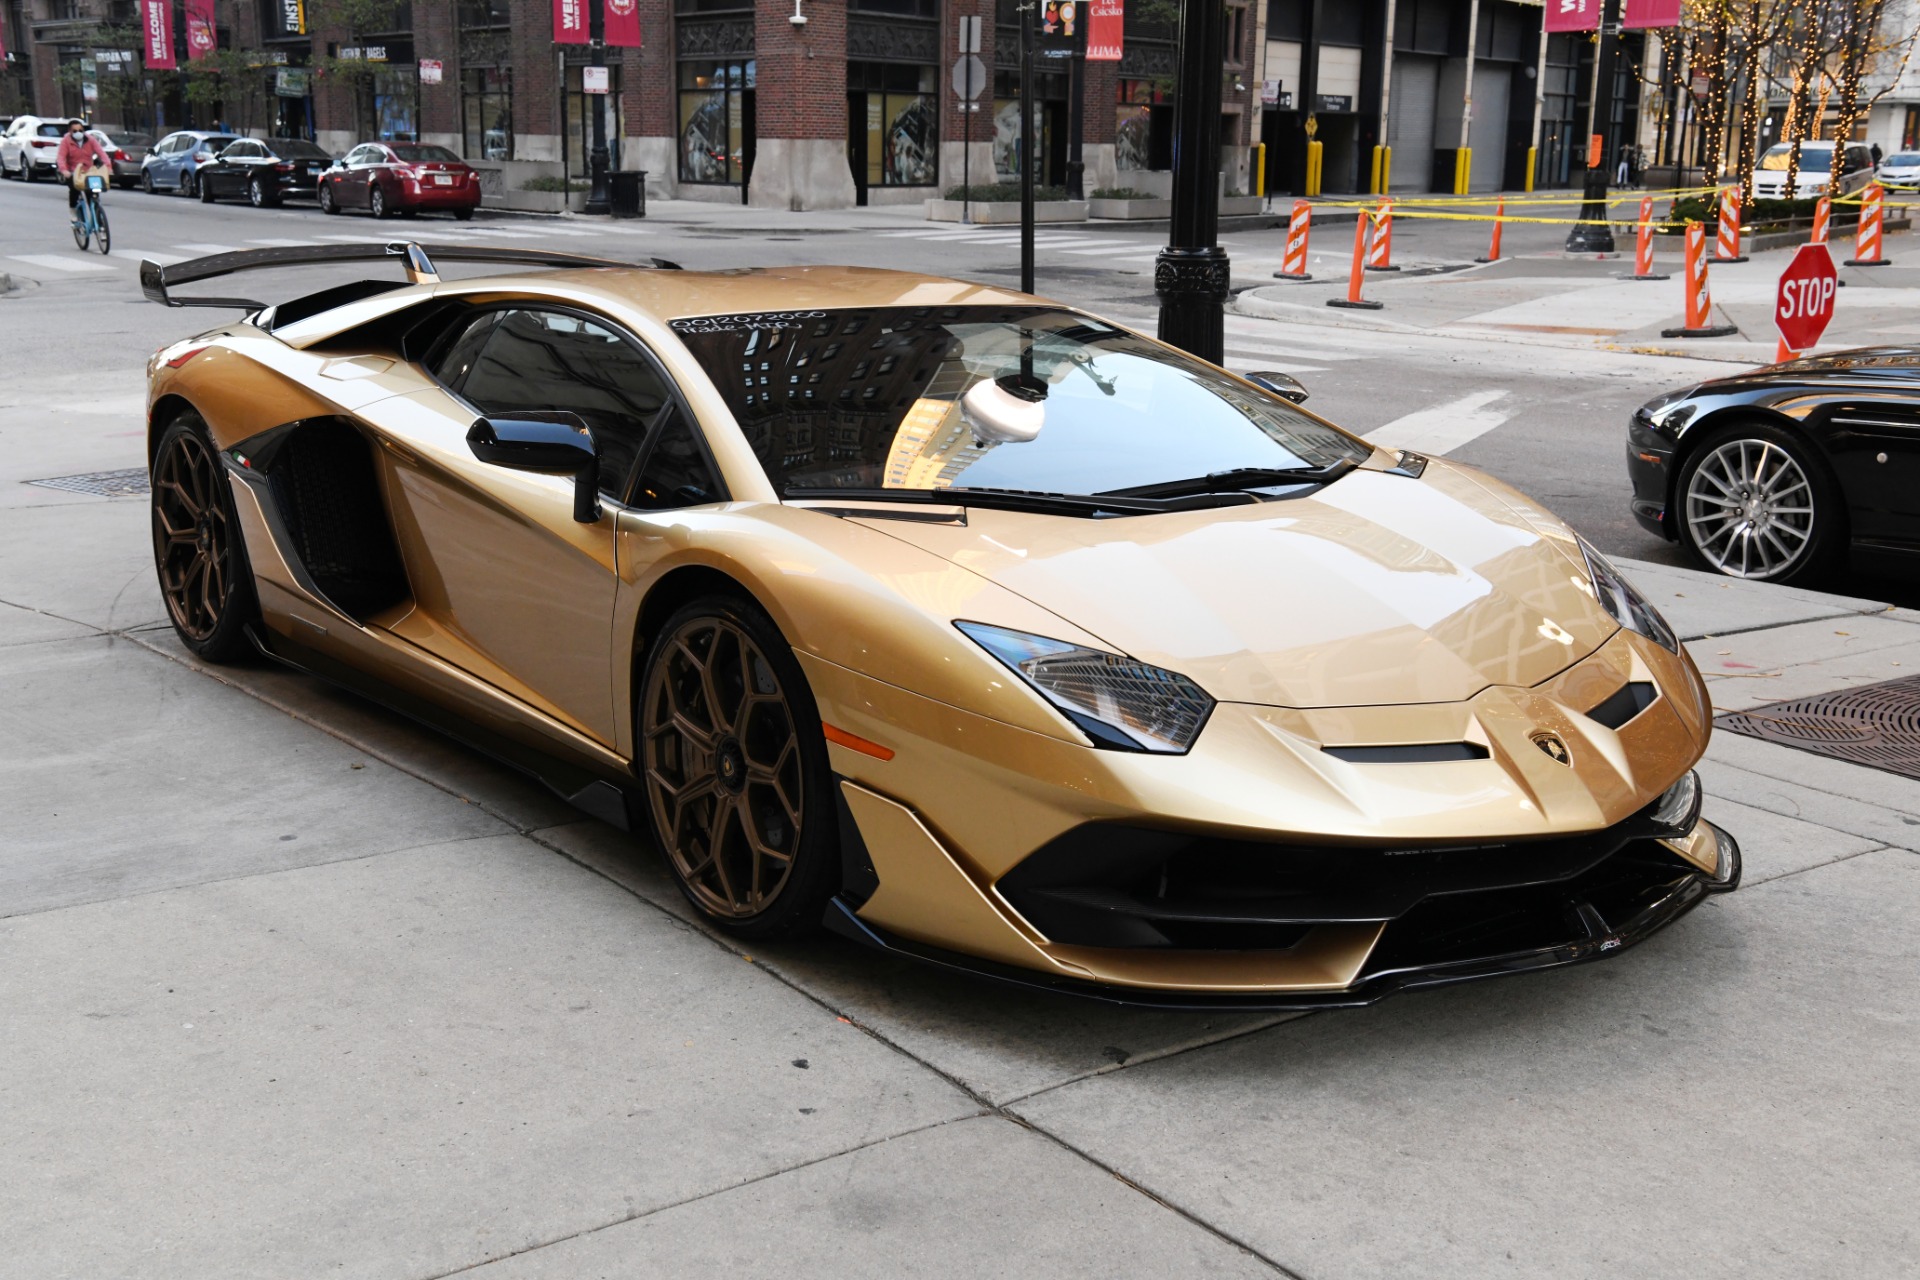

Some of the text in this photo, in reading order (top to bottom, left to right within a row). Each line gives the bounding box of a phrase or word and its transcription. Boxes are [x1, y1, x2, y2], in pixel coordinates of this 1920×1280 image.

[285, 0, 299, 32] EINST
[1091, 6, 1123, 16] Csicsko
[148, 1, 162, 60] WELCOME
[366, 46, 387, 59] BAGELS
[1086, 46, 1122, 57] LUMA
[1780, 277, 1834, 319] STOP
[672, 311, 826, 327] 0012072000
